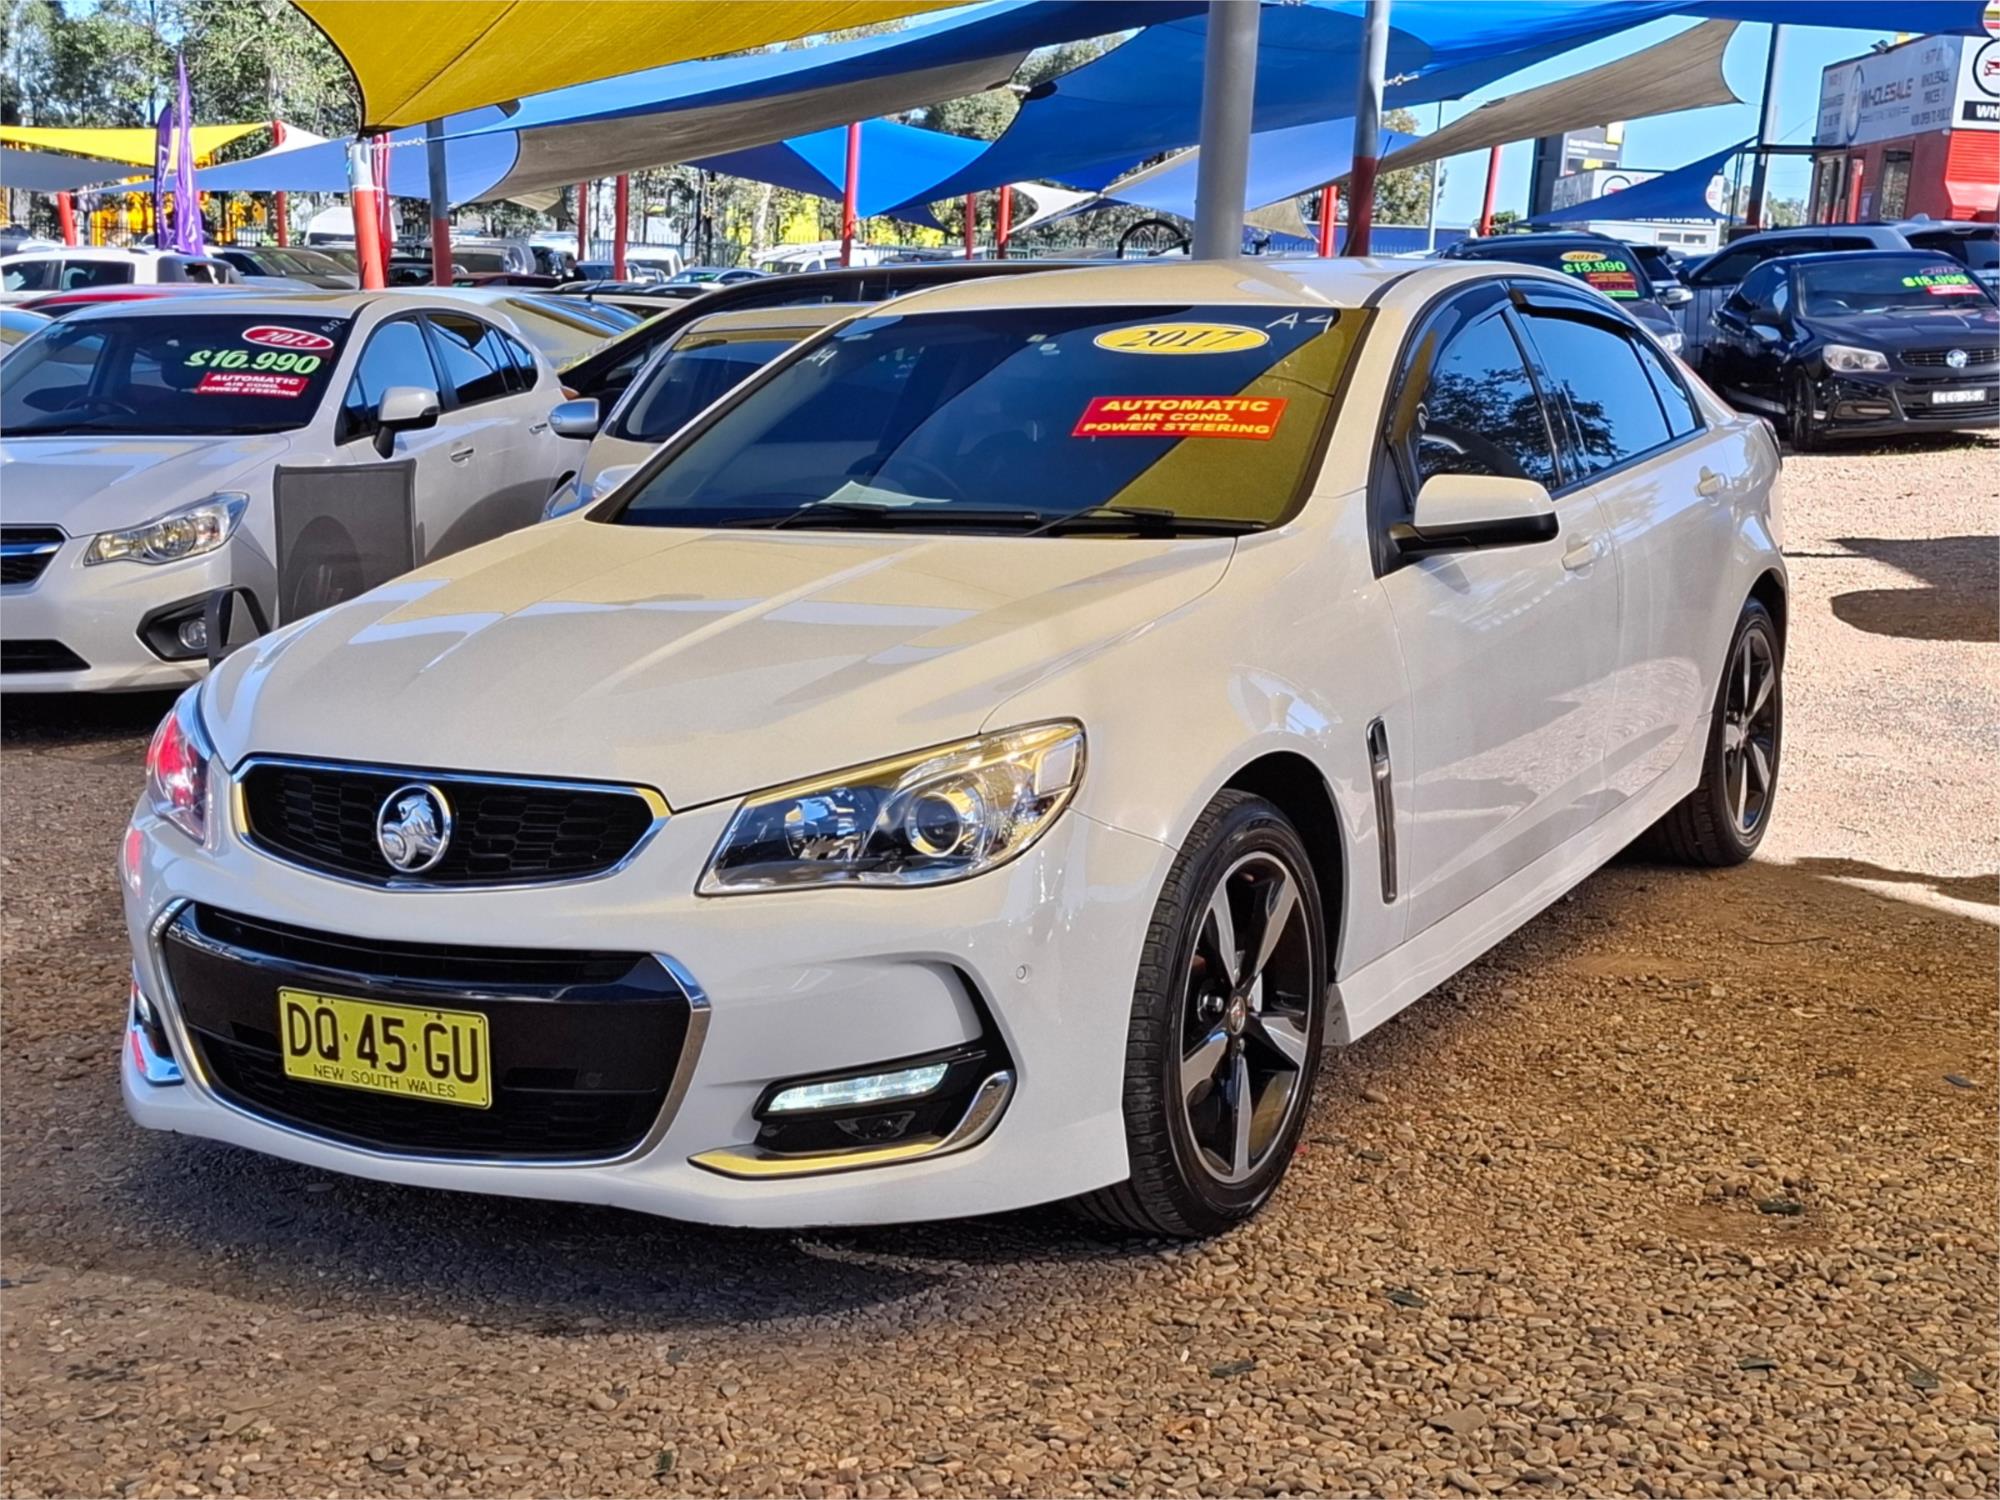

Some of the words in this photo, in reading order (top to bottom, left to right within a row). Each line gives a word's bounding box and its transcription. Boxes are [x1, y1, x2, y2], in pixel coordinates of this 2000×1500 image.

[254, 331, 318, 347] 2013
[1119, 329, 1247, 348] 2017
[184, 350, 321, 375] $16.990
[210, 374, 299, 386] AUTOMATIC
[200, 385, 237, 393] POWER
[241, 387, 298, 397] STEERING
[1100, 399, 1271, 412] AUTOMATIC
[1127, 413, 1163, 422] AIR
[1169, 413, 1234, 422] COND.
[1082, 423, 1157, 432] POWER
[1162, 423, 1270, 434] STEERING
[313, 1064, 345, 1082] NEW
[352, 1071, 400, 1090] SOUTH
[407, 1078, 456, 1098] WALES
